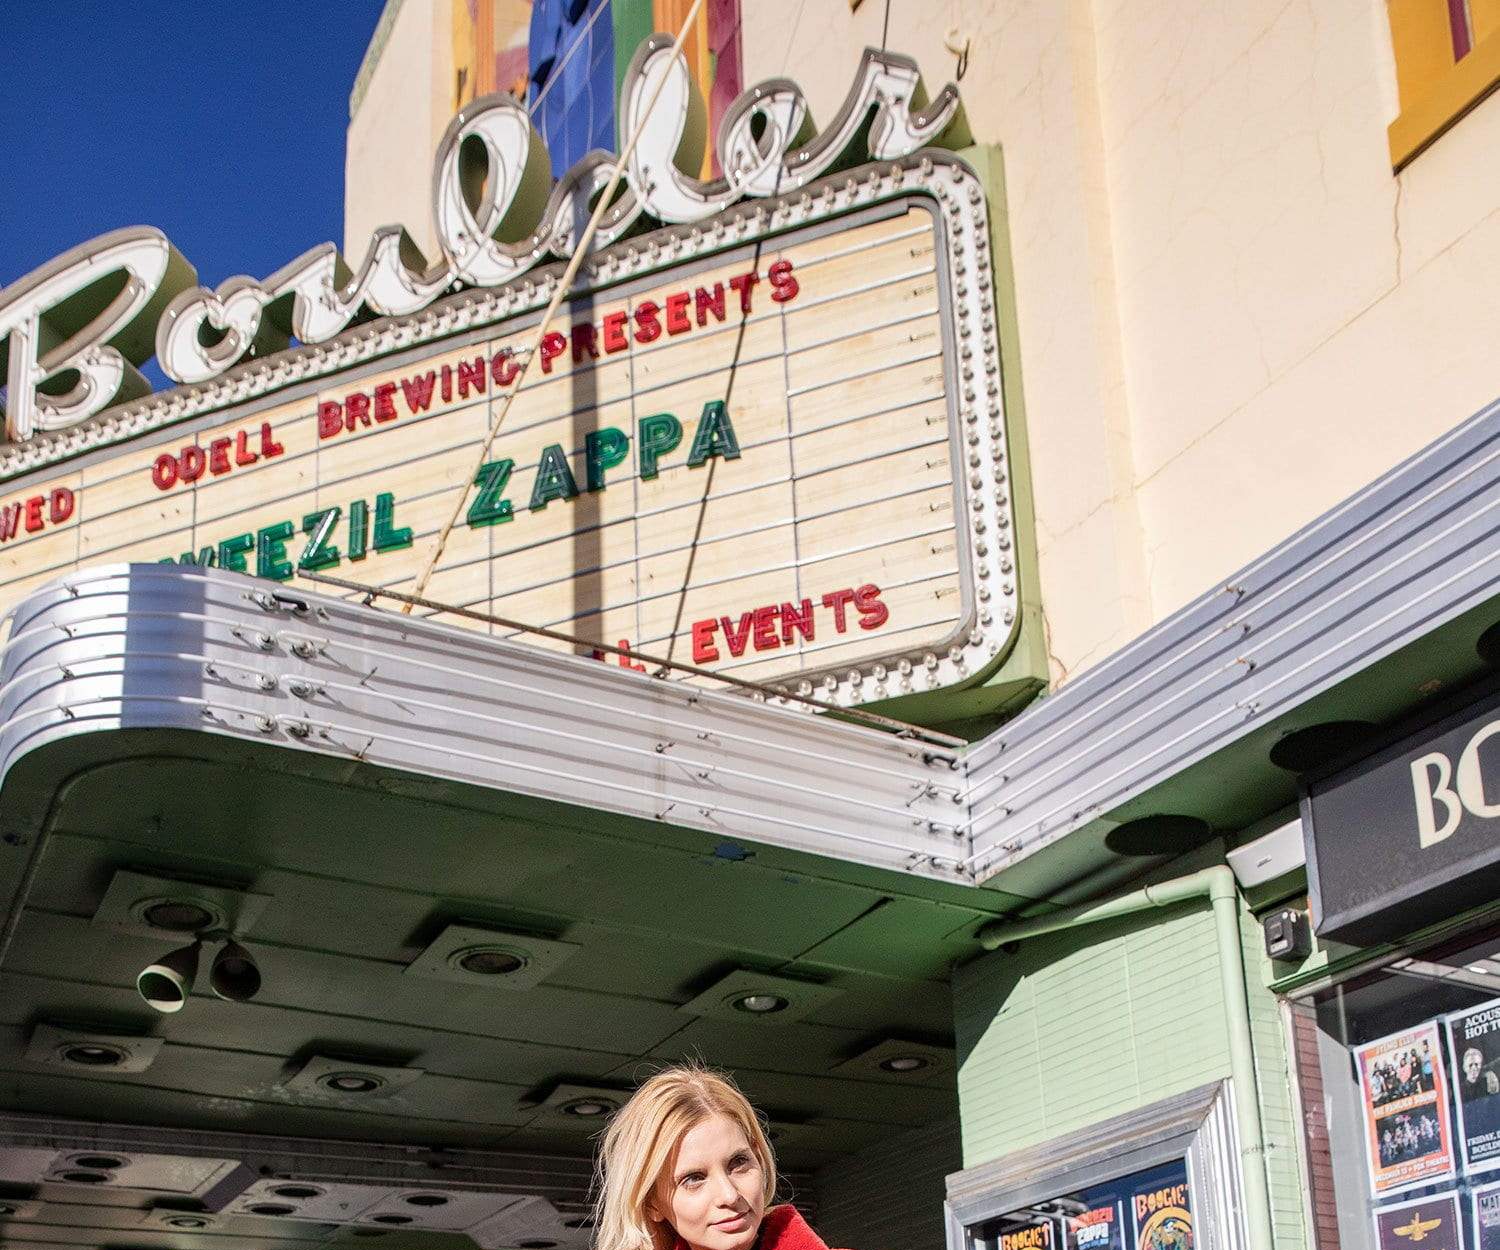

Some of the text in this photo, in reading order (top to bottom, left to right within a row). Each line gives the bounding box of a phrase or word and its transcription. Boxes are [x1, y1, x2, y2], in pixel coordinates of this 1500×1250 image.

[152, 259, 800, 490] ODELL BREWING PRESENTS
[467, 400, 742, 528] ZAPPA
[692, 583, 889, 664] EVENTS
[1465, 1022, 1489, 1040] HOT
[1136, 1184, 1186, 1221] BOOGIE
